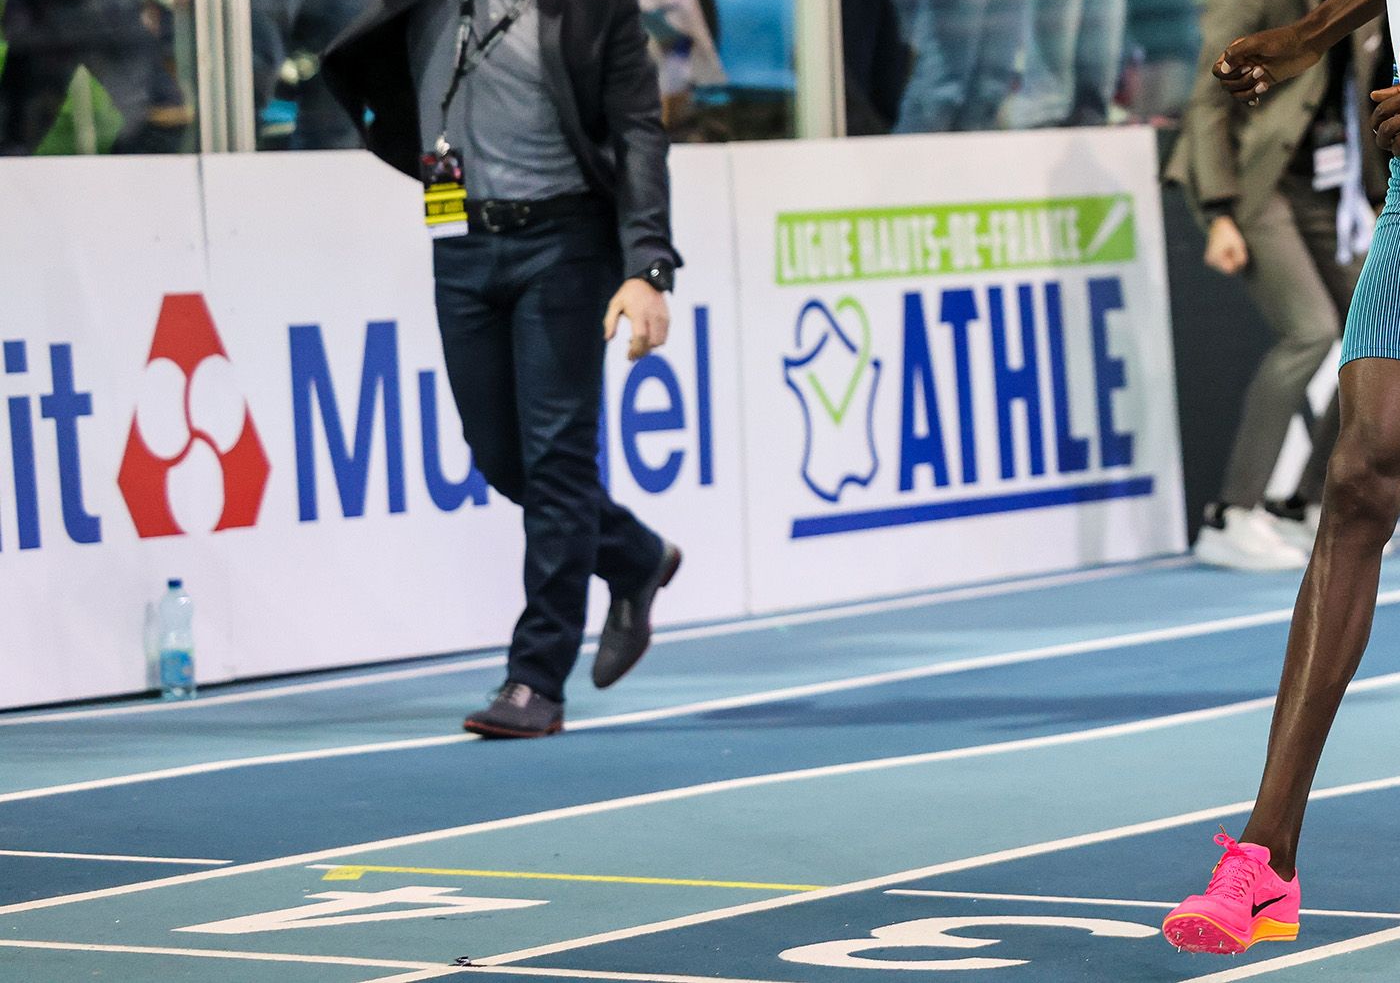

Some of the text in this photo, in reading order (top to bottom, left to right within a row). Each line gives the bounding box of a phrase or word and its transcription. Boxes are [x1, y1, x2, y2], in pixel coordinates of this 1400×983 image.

[780, 206, 1082, 280] LIGUE HAUTS-DE-FRANCE
[288, 304, 714, 522] Muel
[898, 275, 1135, 493] ATHLE
[169, 885, 551, 934] 4
[778, 915, 1161, 970] 3
